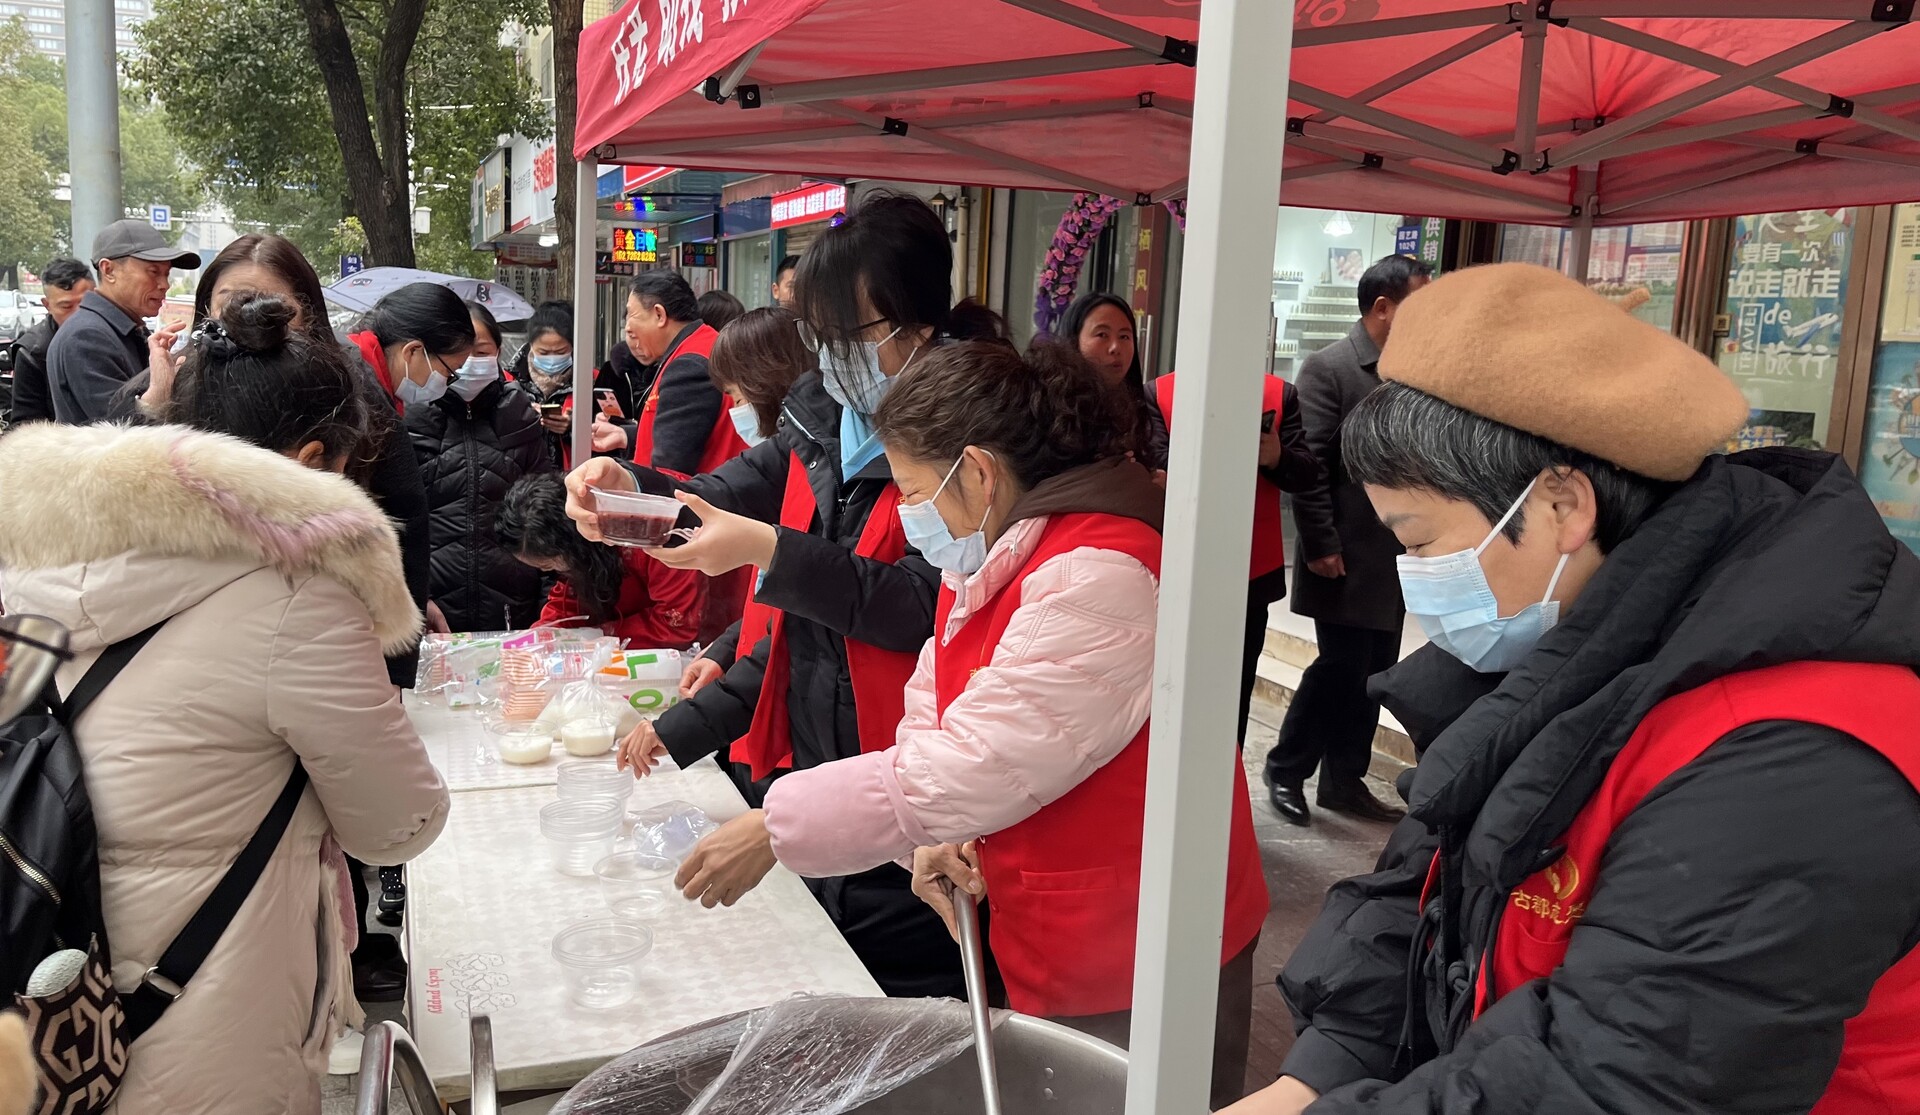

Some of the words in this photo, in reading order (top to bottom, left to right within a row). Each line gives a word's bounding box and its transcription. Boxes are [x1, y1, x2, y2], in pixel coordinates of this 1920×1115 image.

[1742, 241, 1822, 264] 要有一次
[1728, 267, 1841, 298] 说走就走
[1764, 302, 1792, 325] de
[1739, 307, 1758, 369] TRAVEL
[1763, 340, 1831, 379] 旅行
[426, 968, 444, 988] lucky
[426, 990, 442, 1014] puppy
